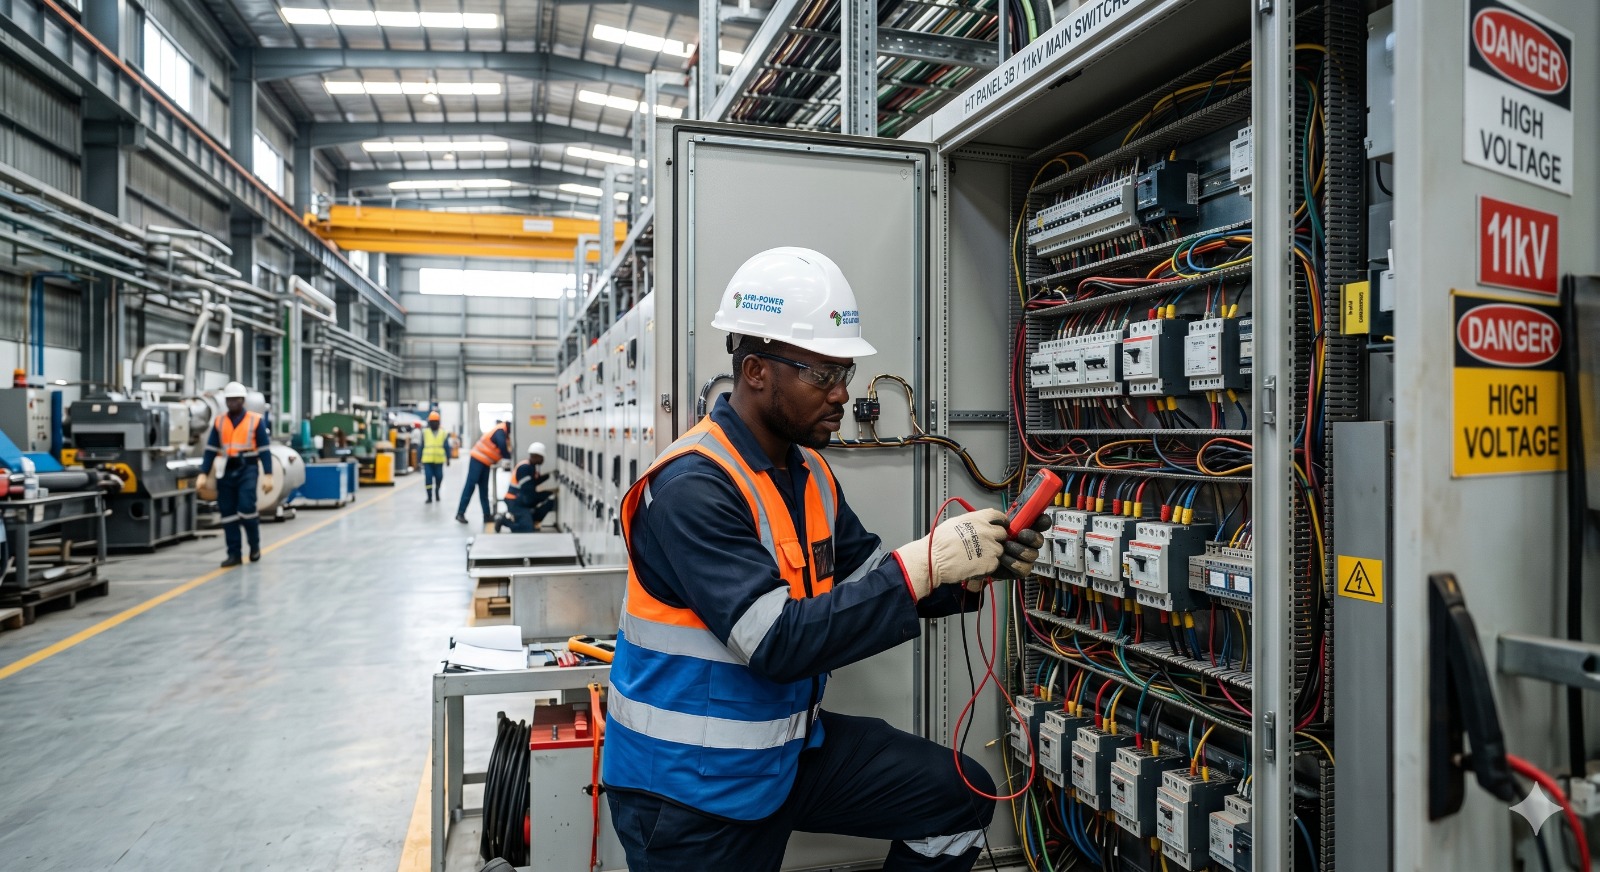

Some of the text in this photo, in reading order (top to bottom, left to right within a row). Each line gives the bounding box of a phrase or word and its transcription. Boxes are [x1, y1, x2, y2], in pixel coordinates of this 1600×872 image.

[965, 93, 975, 114] HT
[976, 76, 1002, 105] PANEL
[1004, 66, 1015, 86] 3B
[1022, 45, 1043, 73] 11kV
[1046, 25, 1072, 58] MAIN
[1482, 15, 1562, 86] DANGER
[1501, 96, 1543, 140] HIGH
[1480, 129, 1562, 184] VOLTAGE
[1487, 212, 1550, 280] 11kV
[742, 301, 782, 314] SOLUTIONS
[743, 294, 785, 306] AFRI-POWER
[1468, 316, 1554, 354] DANGER
[1488, 384, 1538, 415] HIGH
[1464, 426, 1560, 459] VOLTAGE
